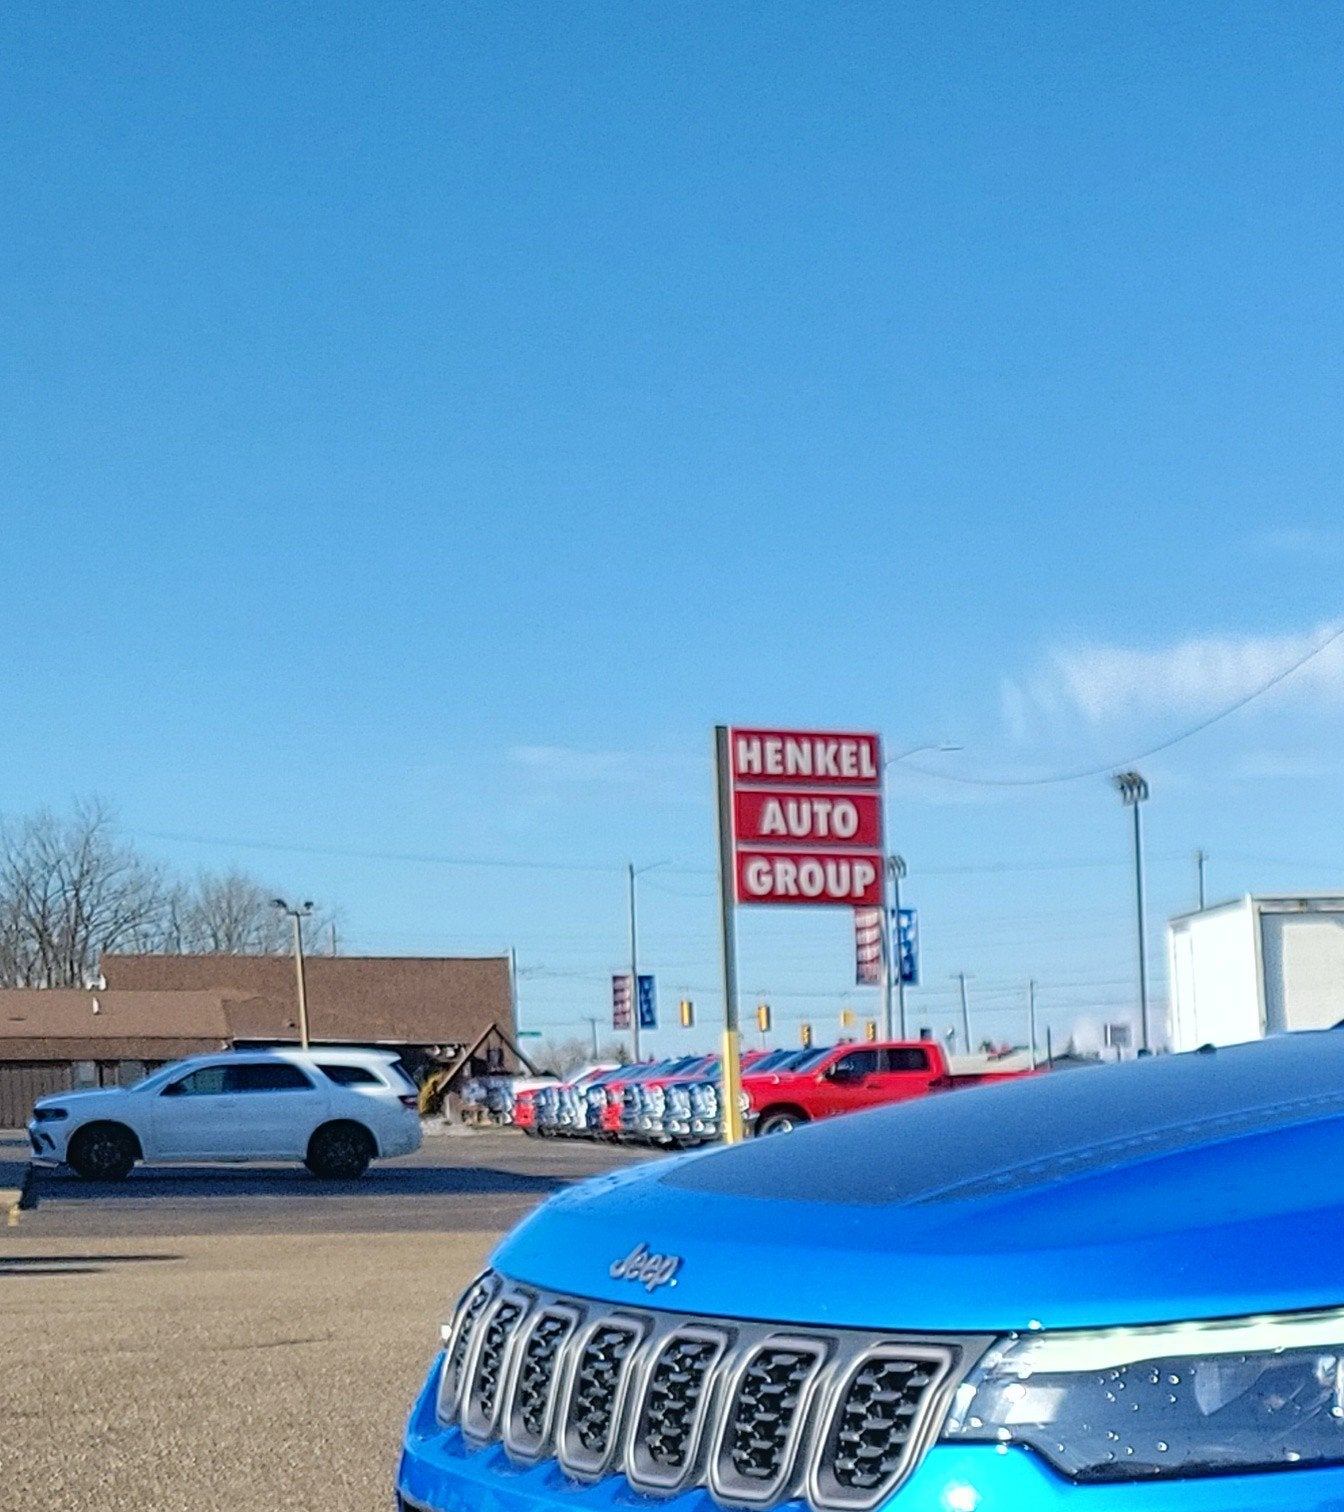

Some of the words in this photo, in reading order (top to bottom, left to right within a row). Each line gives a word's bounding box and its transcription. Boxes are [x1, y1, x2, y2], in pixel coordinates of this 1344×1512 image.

[737, 735, 876, 778] HENKEL
[759, 797, 859, 838] AUTO
[745, 855, 876, 897] GROUP
[609, 1242, 679, 1291] Jeep
